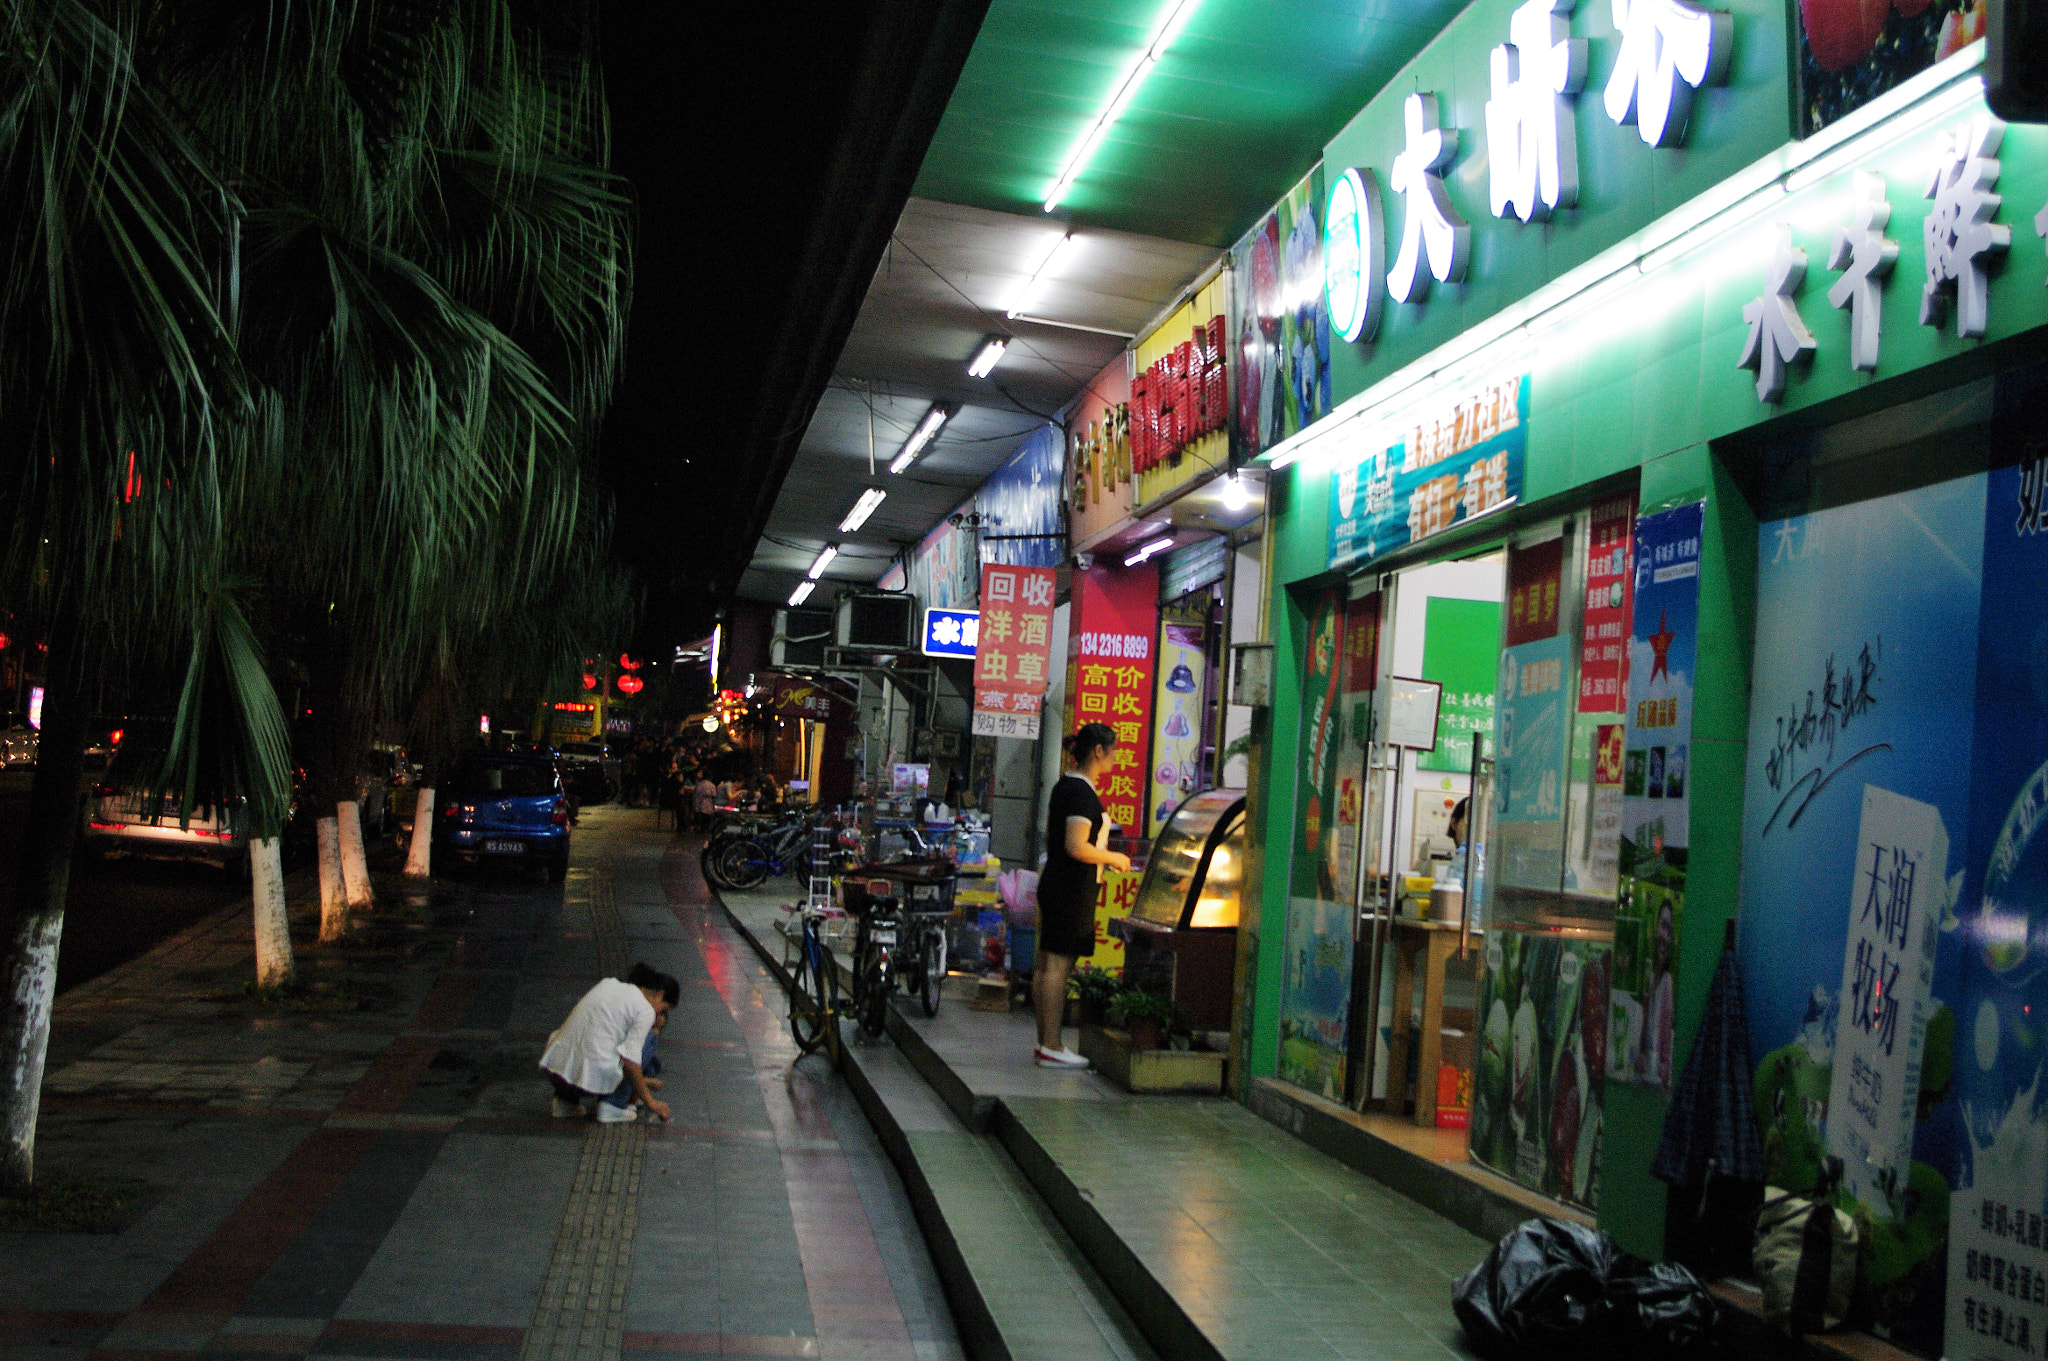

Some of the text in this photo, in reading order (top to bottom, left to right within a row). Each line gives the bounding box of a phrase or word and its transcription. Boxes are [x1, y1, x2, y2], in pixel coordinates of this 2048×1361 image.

[1737, 113, 2048, 402] 水牛鲜
[988, 571, 1052, 607] 回收
[984, 609, 1049, 646] 洋酒
[1081, 632, 1149, 658] 134 2316 8899
[981, 649, 1046, 685] 虫草
[1081, 664, 1146, 689] 高价
[1081, 692, 1144, 717] 回收
[977, 714, 1037, 736] 购物卡
[1861, 842, 1917, 952] 天润
[1852, 936, 1901, 1056] 牧场
